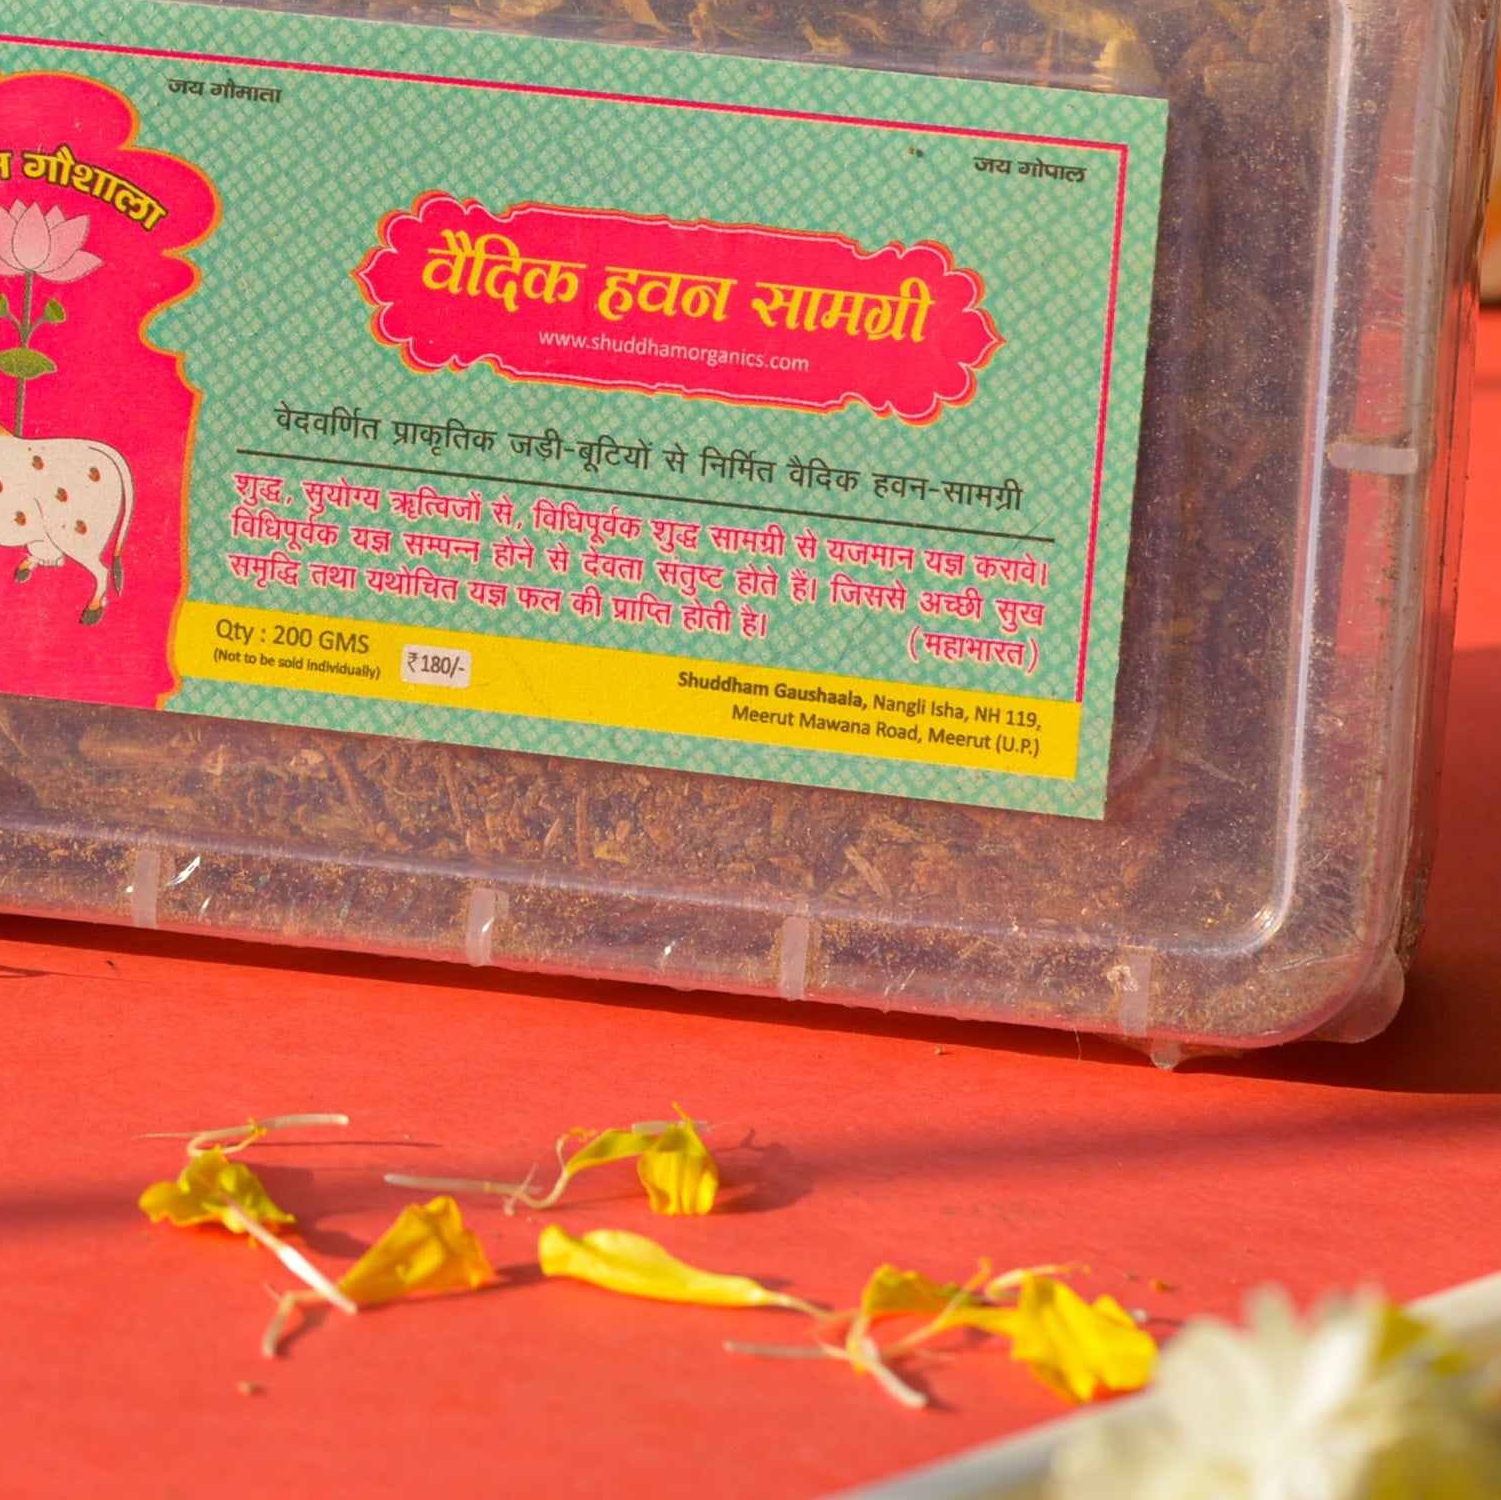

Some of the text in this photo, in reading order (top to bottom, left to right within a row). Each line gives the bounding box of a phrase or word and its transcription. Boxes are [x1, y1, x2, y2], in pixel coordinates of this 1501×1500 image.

[168, 77, 206, 98] जय
[22, 143, 167, 232] गौशाला
[972, 155, 1086, 184] जय गोपाल
[421, 227, 934, 342] वैदिक हवन सामग्री
[537, 327, 810, 375] www.shuddhamorganics.com
[274, 401, 381, 441] वेदवर्णित
[392, 418, 497, 456] प्राकृतिक
[663, 444, 686, 475] से
[699, 449, 776, 484] निर्मित
[787, 456, 861, 492] वैदिक
[873, 471, 1023, 510] हवन-सामग्री
[303, 477, 380, 516] सुयोग्य
[493, 493, 524, 531] से,
[533, 501, 642, 544] विधिपूर्वक
[651, 517, 701, 553] शुद्ध
[709, 522, 785, 557] सामग्री
[795, 527, 818, 559] से
[826, 542, 914, 571] यजमान
[924, 552, 965, 578] यज्ञ
[227, 551, 300, 589] समृद्धि
[308, 562, 357, 589] तथा
[366, 565, 460, 602] यथोचित
[467, 582, 507, 608] यज्ञ
[516, 586, 562, 613] फल
[571, 587, 602, 618] की
[611, 592, 673, 626] प्राप्ति
[682, 599, 731, 630] होती
[230, 510, 340, 550] विधिपूर्वक
[351, 524, 391, 553] यज्ञ
[404, 532, 480, 564] सम्पन्न
[493, 533, 534, 569] होने
[545, 544, 570, 572] से
[581, 548, 644, 583] देवता
[655, 553, 724, 595] संतुष्ट
[736, 562, 779, 598] होते
[830, 575, 907, 612] जिससे
[919, 586, 983, 621] अच्छी
[995, 595, 1046, 633] सुख
[215, 617, 254, 644] Qty
[272, 626, 313, 648] 200
[318, 632, 370, 655] GMS
[908, 625, 1039, 674] (महाभारत)
[214, 647, 381, 681] (Not to be sold individually)
[407, 649, 465, 679] ₹180/-
[678, 671, 1042, 731] Shuddham Gaushaala, Nangli Isha, NH 119,
[732, 704, 1040, 758] Meerut Mawana Road, Meerut (U.P.)
